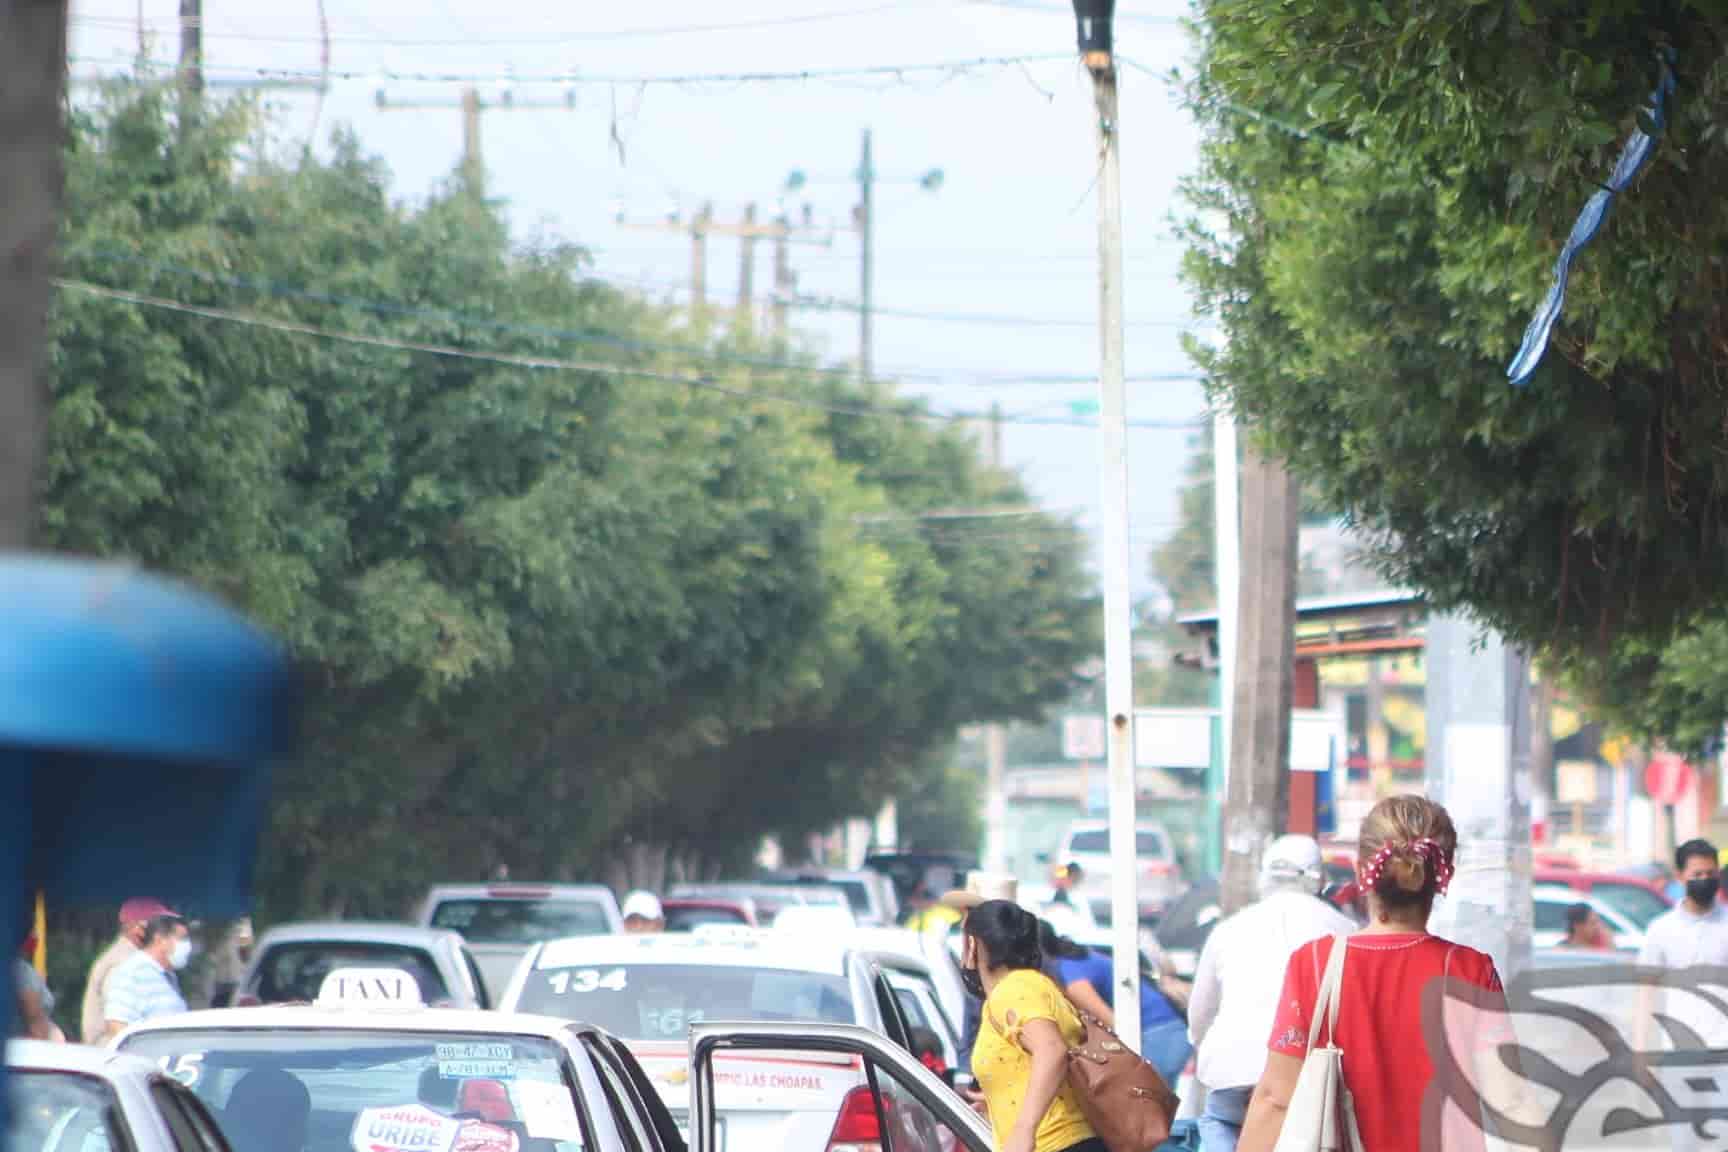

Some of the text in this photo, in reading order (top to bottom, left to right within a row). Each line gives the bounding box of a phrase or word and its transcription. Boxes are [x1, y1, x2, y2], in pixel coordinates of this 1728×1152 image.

[331, 978, 403, 999] TAXI
[549, 968, 627, 994] 134
[379, 1111, 442, 1128] GRUPO
[367, 1119, 442, 1147] URIBE
